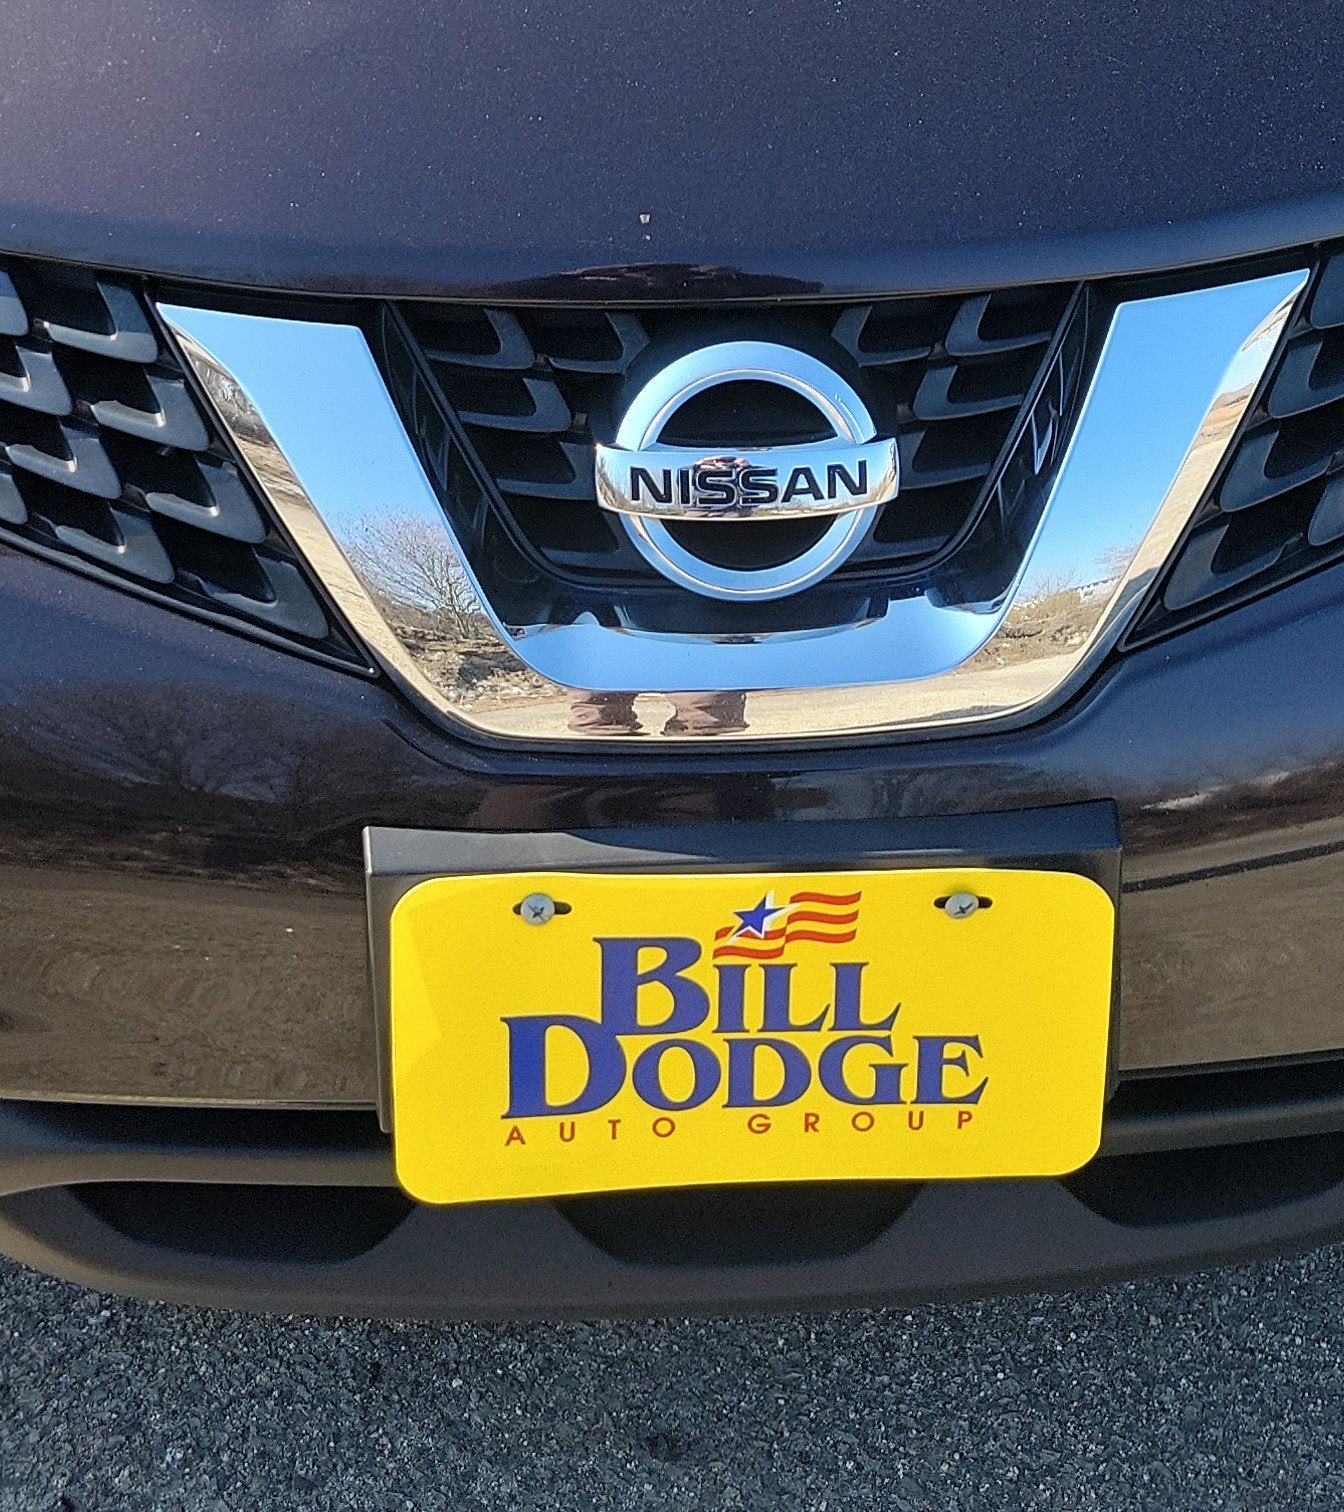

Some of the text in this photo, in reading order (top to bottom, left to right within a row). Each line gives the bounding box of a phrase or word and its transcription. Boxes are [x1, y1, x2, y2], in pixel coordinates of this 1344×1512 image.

[630, 459, 868, 506] NISSAN
[593, 937, 902, 1035] BILL
[500, 1013, 989, 1119] DODGE
[505, 1110, 973, 1147] AUTO GROUP
